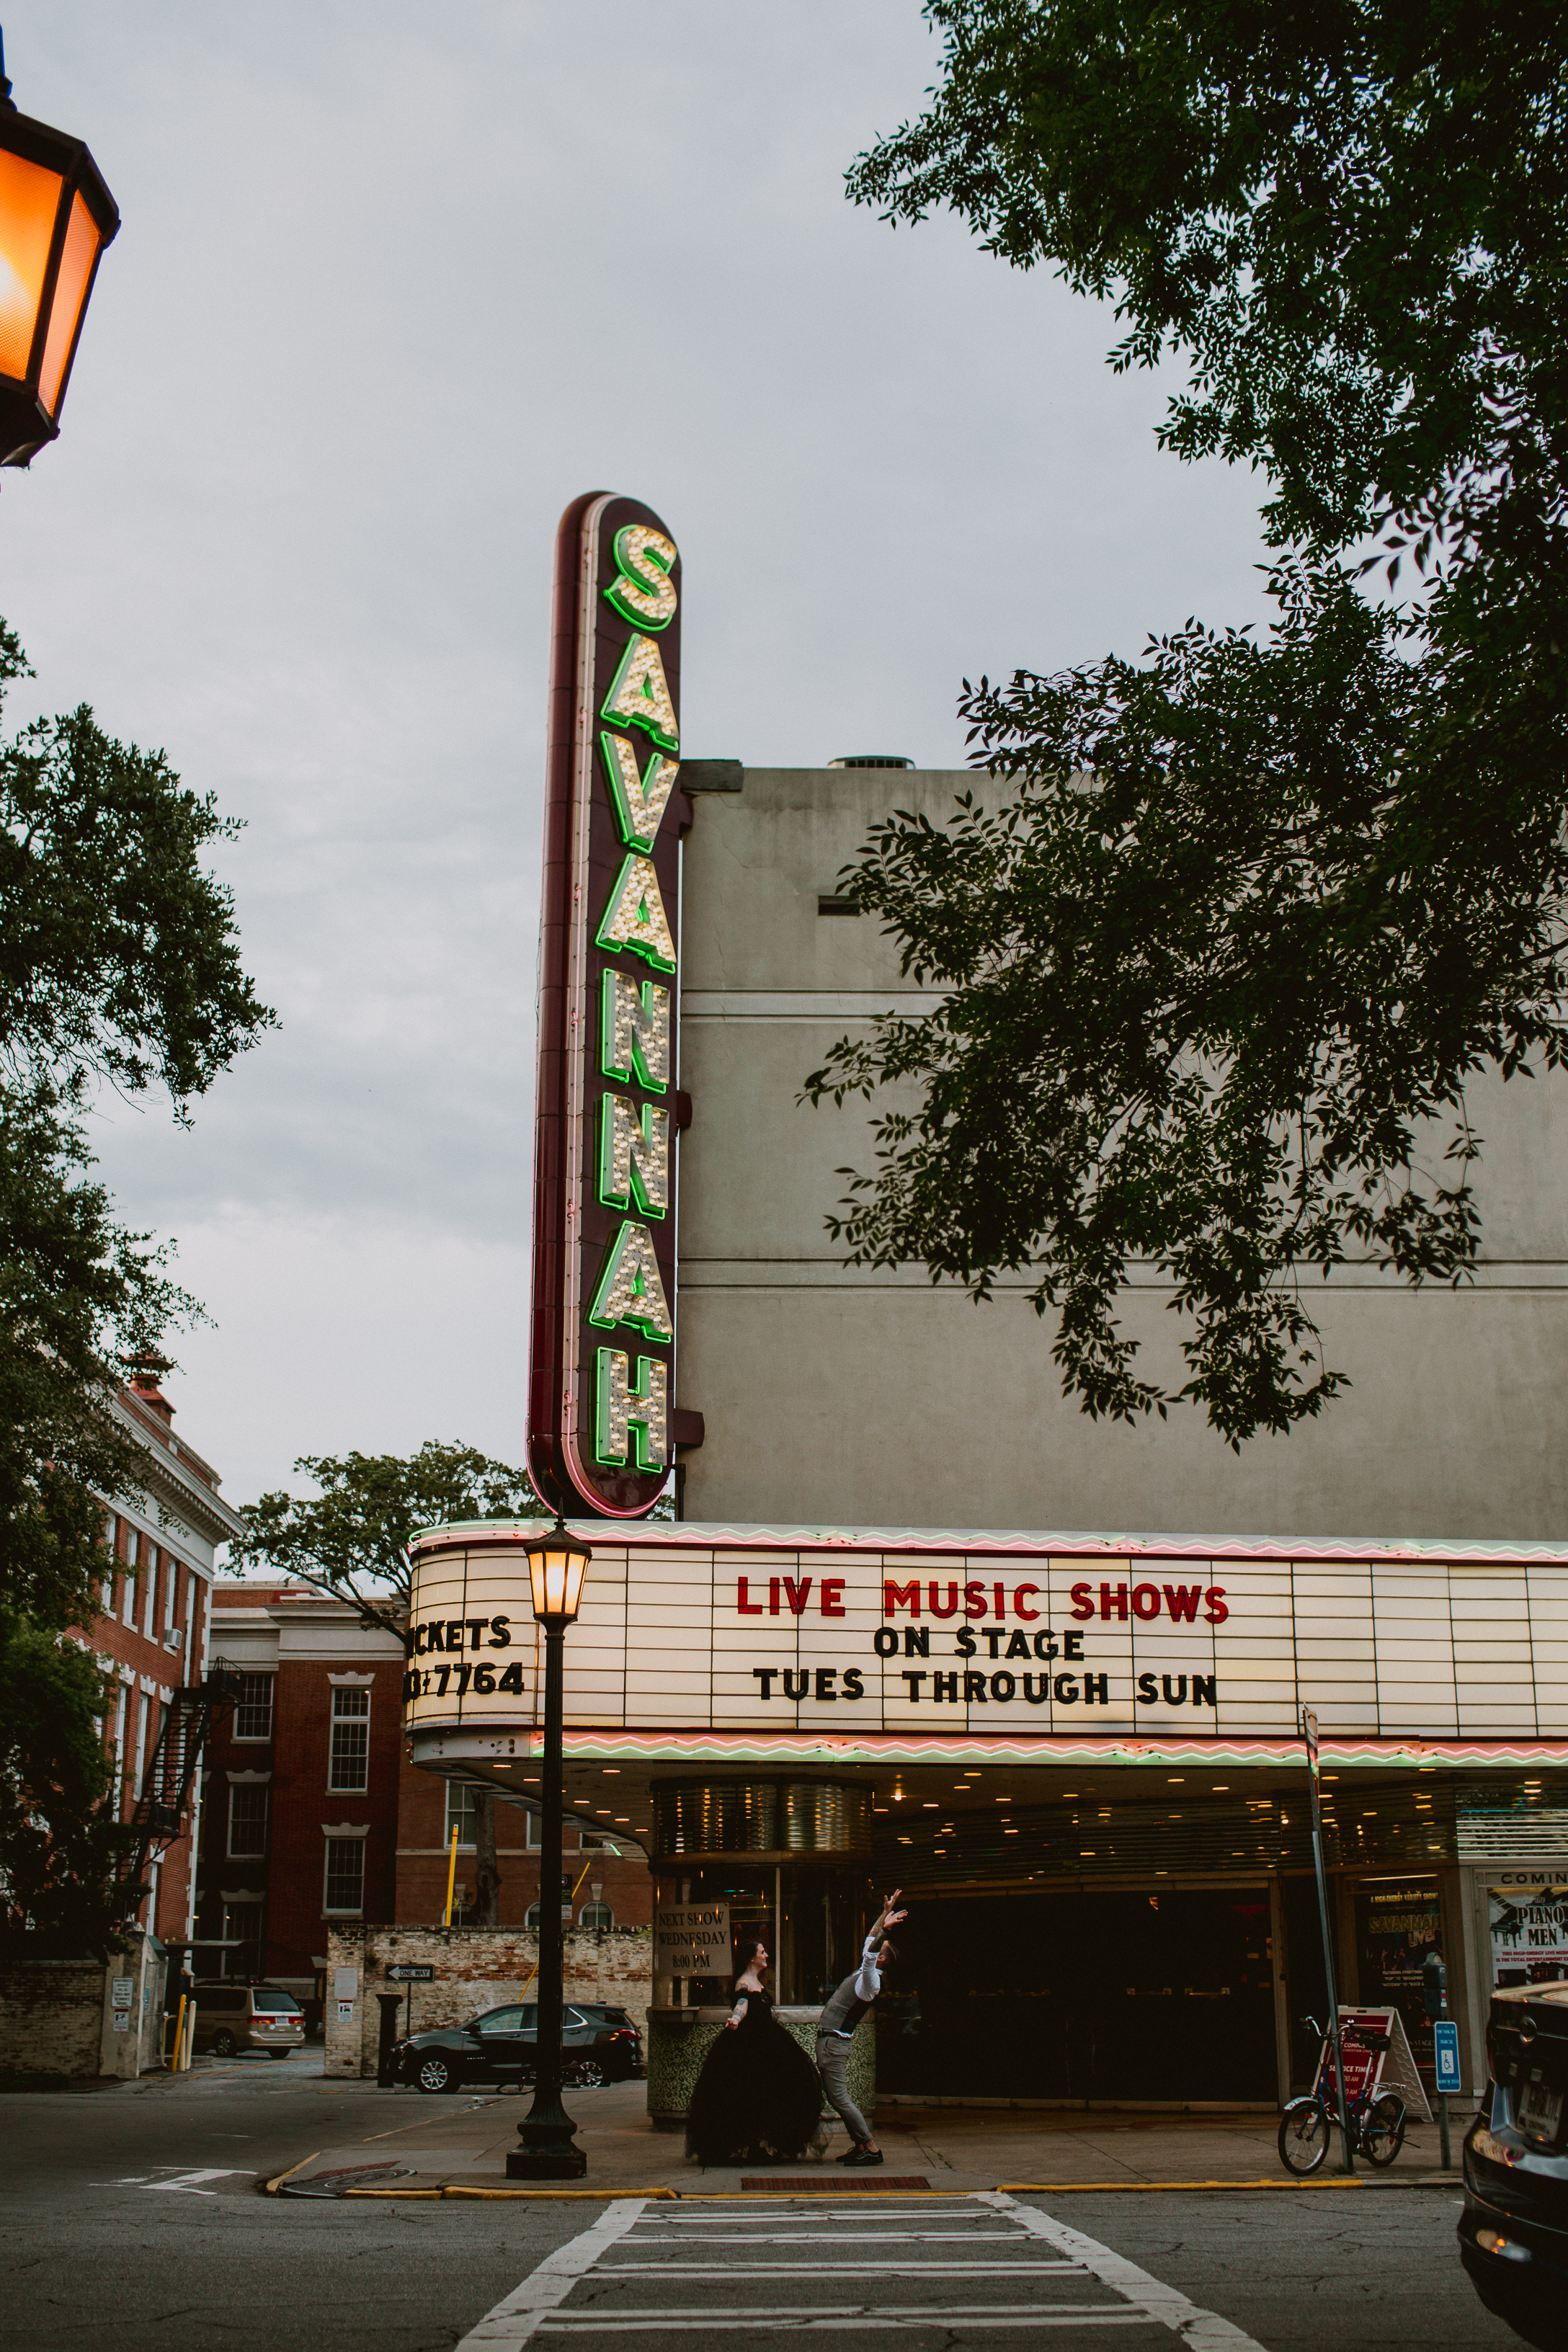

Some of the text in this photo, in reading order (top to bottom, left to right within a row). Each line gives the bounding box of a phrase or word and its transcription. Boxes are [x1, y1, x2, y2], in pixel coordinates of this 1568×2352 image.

[589, 524, 680, 1474] SAVANNAH
[737, 1577, 1229, 1625] LIVE MUSIC SHOWS
[406, 1616, 512, 1660] ICKETS
[873, 1626, 1084, 1661] ON STAGE
[753, 1668, 1217, 1707] TUES THROUGH SUN
[659, 1912, 723, 1926] NEXT SHOW
[1368, 1913, 1441, 1933] SAVANNAH
[1517, 1906, 1564, 1925] PIANO
[659, 1931, 726, 1945] WEDNESDAY
[1528, 1928, 1557, 1946] MEN
[673, 1954, 710, 1968] 8:00 PM
